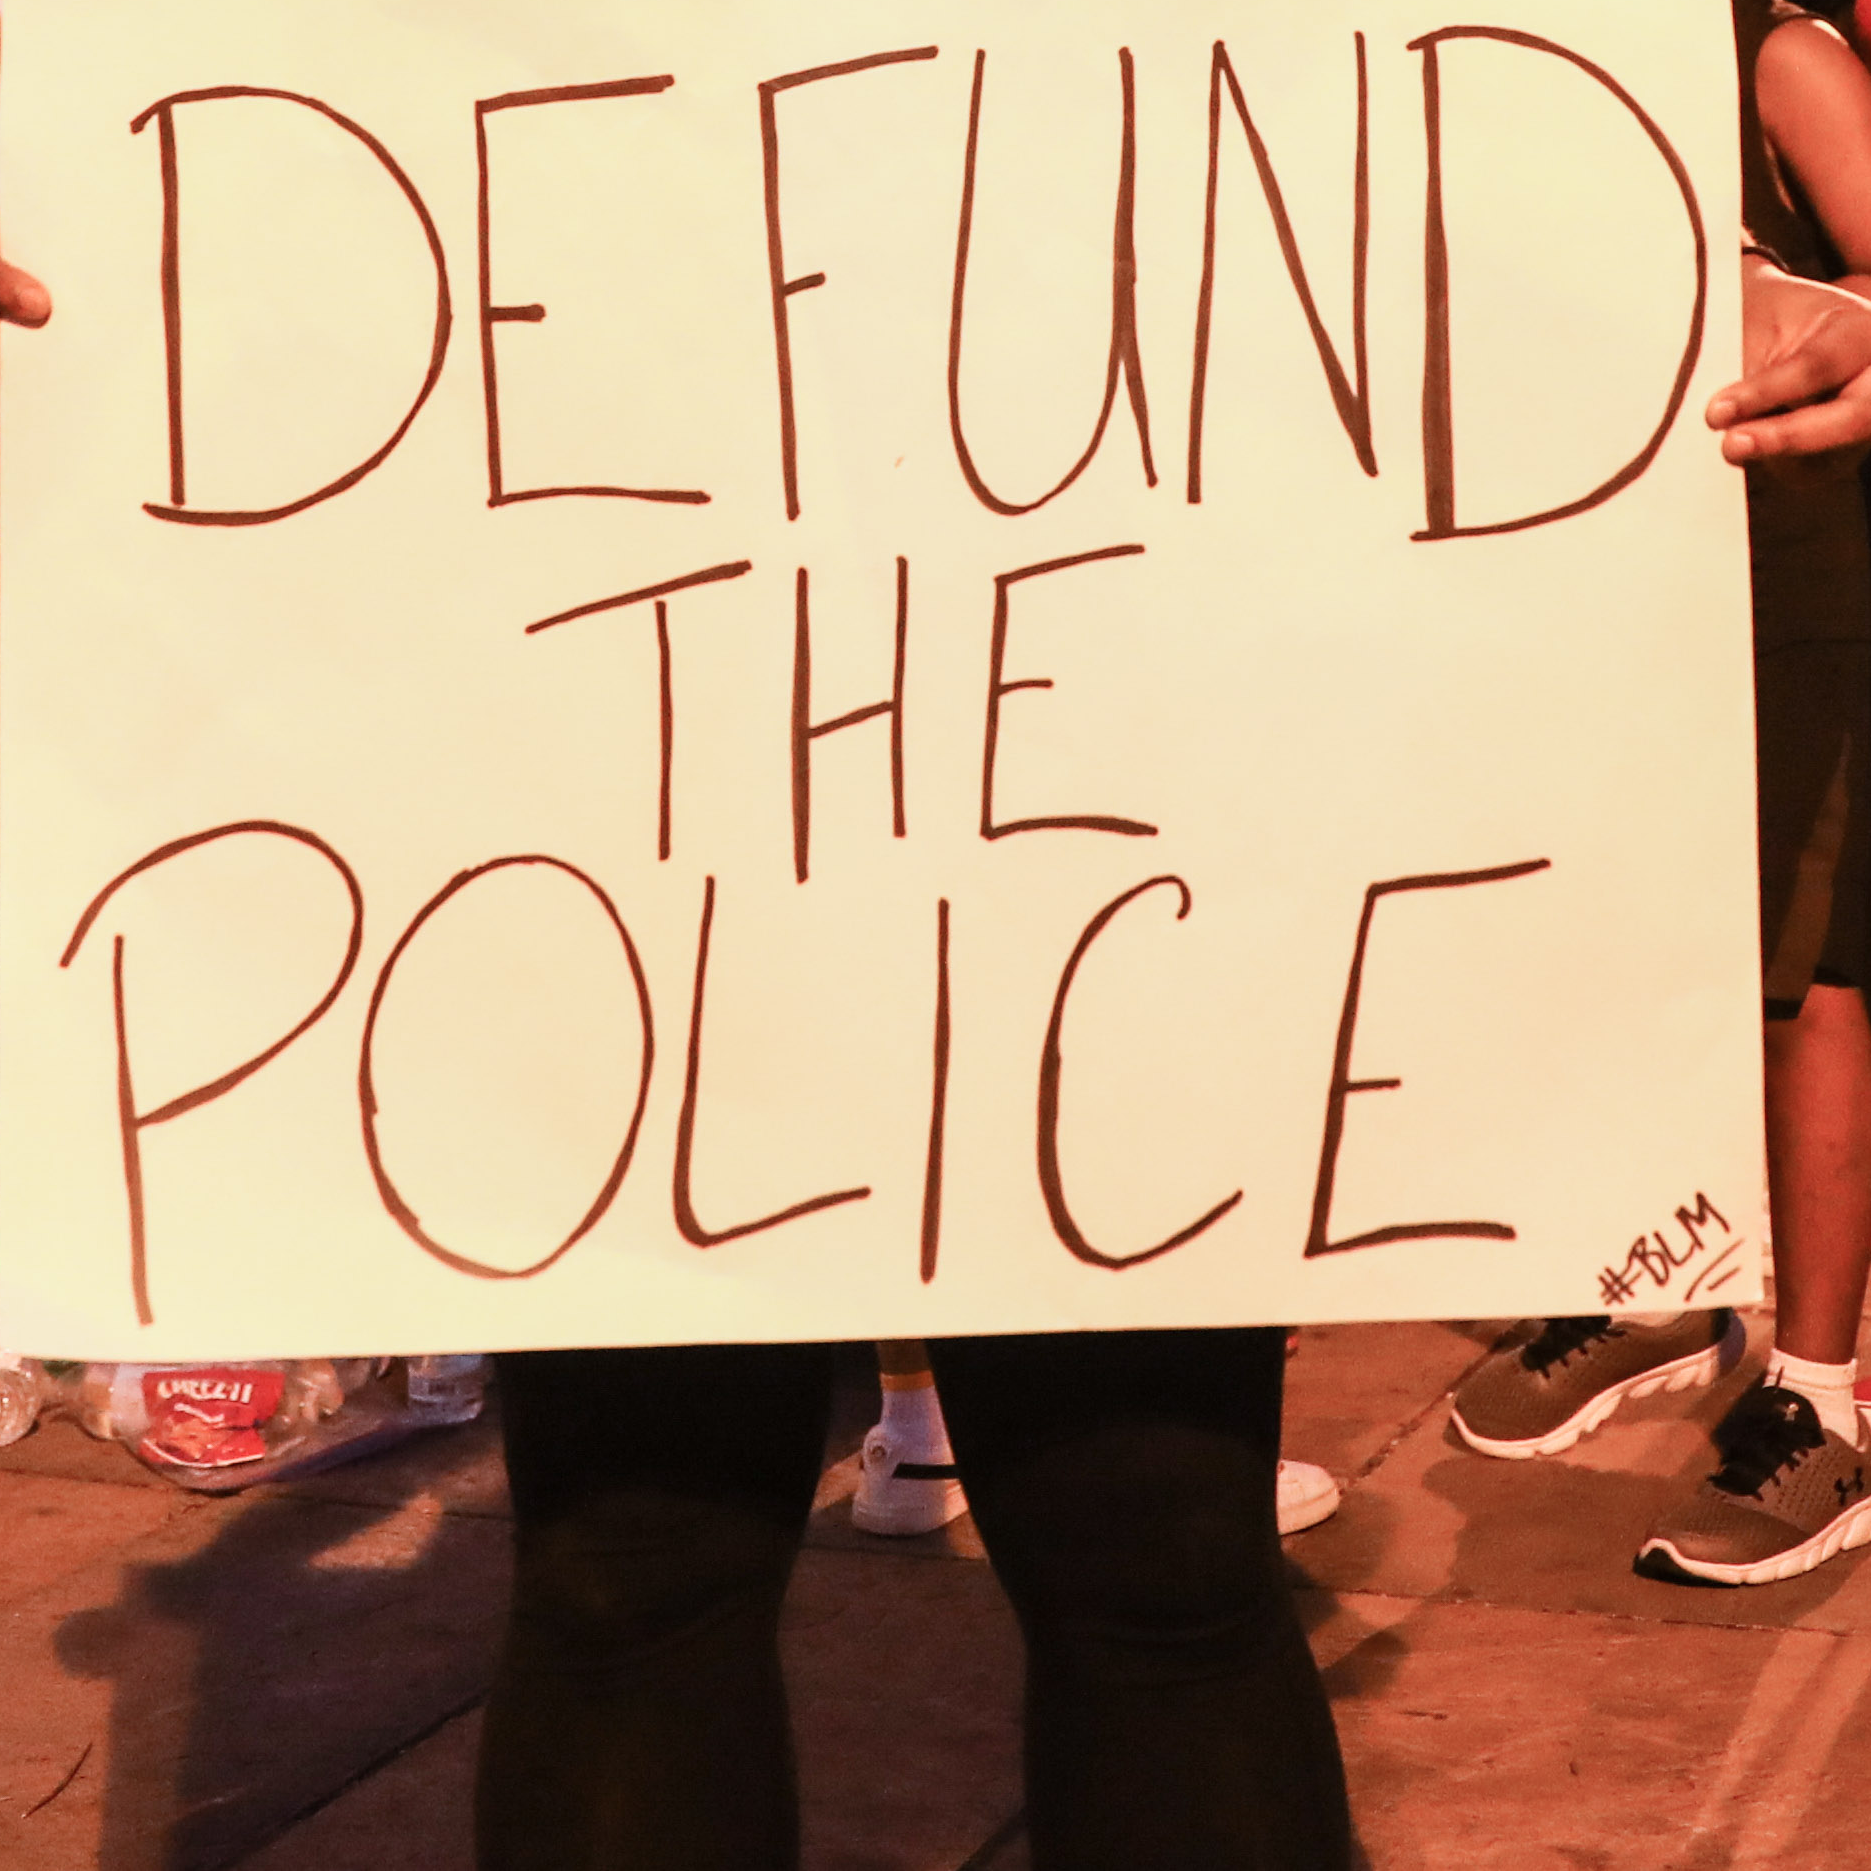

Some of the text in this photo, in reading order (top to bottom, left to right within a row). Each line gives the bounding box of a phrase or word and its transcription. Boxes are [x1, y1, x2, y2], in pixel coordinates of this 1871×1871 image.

[129, 24, 1708, 543] DEFUND
[523, 543, 1160, 885] THE
[58, 819, 1553, 1326] POLICE
[1597, 1191, 1731, 1307] #BLM
